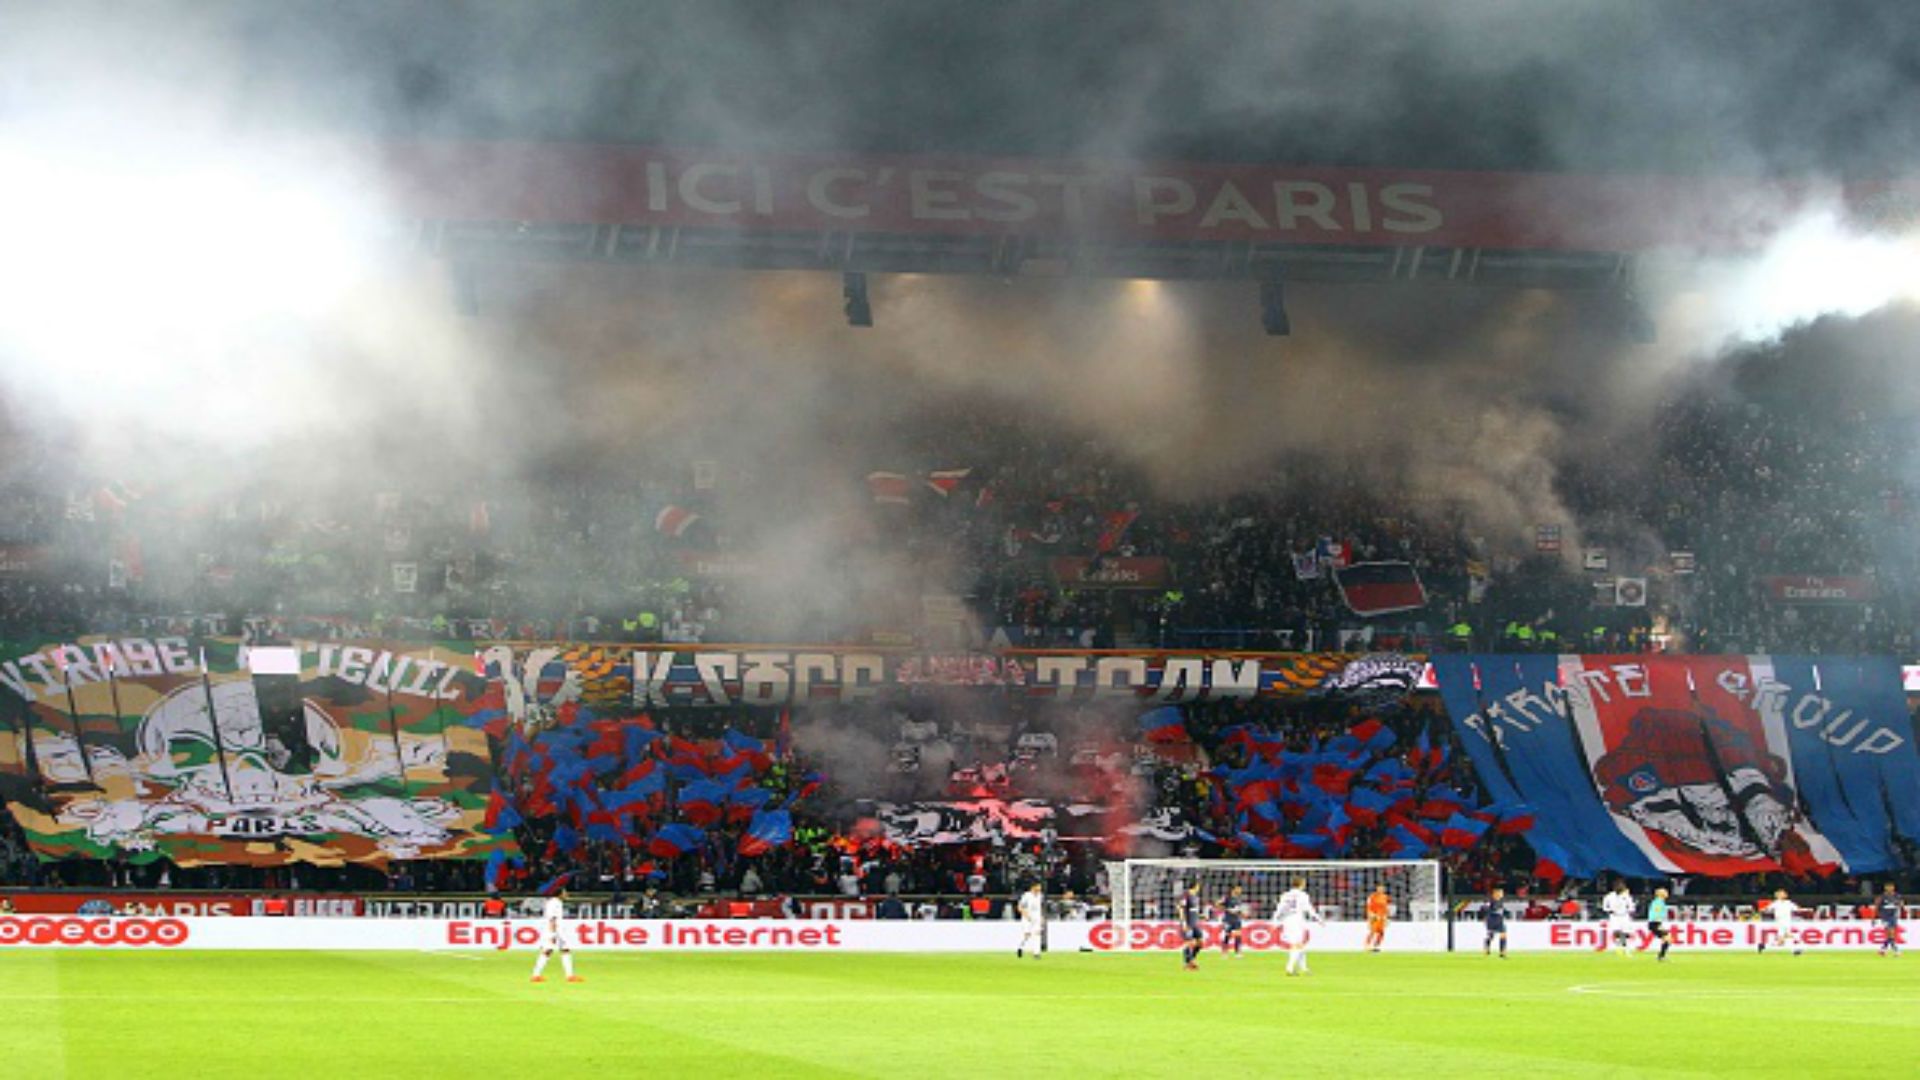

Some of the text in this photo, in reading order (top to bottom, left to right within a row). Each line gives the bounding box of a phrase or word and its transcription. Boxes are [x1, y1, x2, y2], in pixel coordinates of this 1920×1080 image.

[646, 161, 1443, 233] ICI C'EST PARIS
[447, 922, 841, 949] Enjo the Internet
[1550, 923, 1656, 949] Enjy
